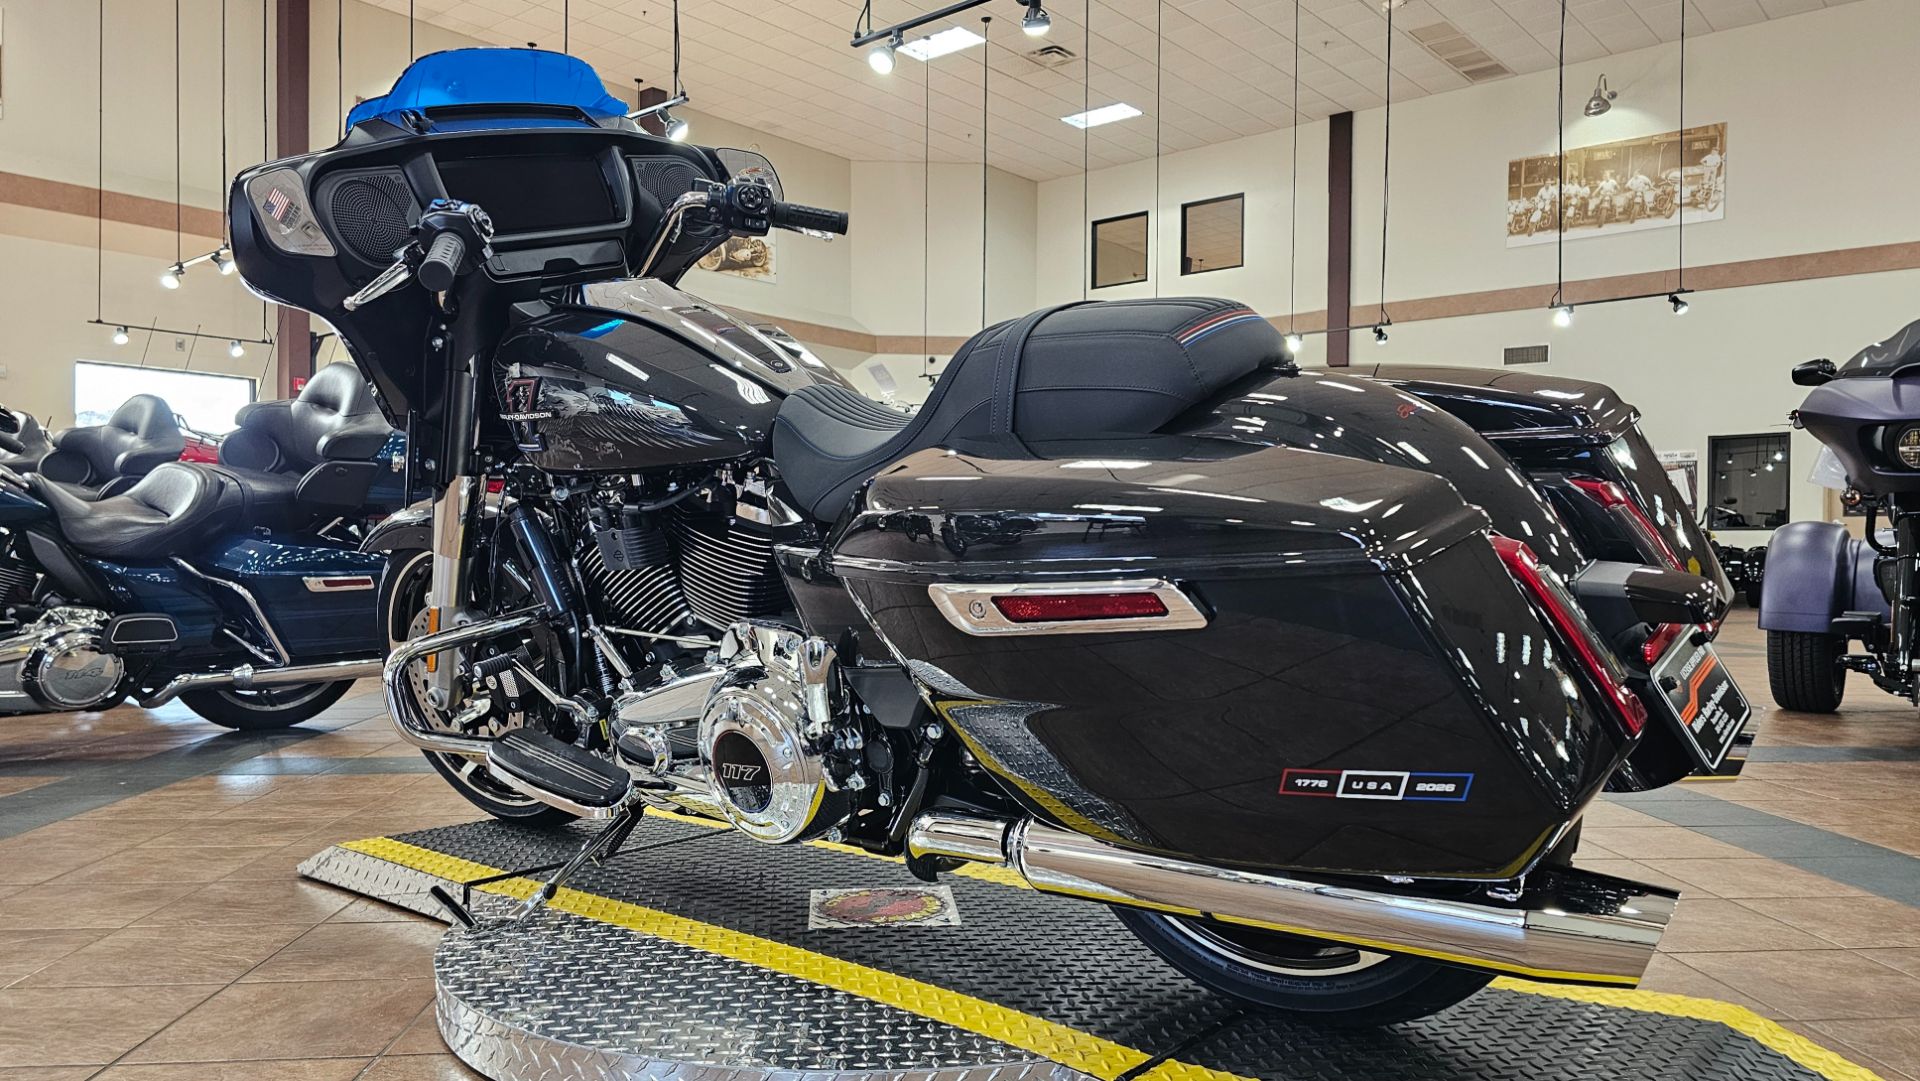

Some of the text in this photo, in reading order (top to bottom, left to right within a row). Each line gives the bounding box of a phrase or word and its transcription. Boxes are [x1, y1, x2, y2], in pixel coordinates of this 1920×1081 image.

[722, 763, 761, 781] 117
[1295, 779, 1328, 788] 1776
[1415, 783, 1457, 792] 2026
